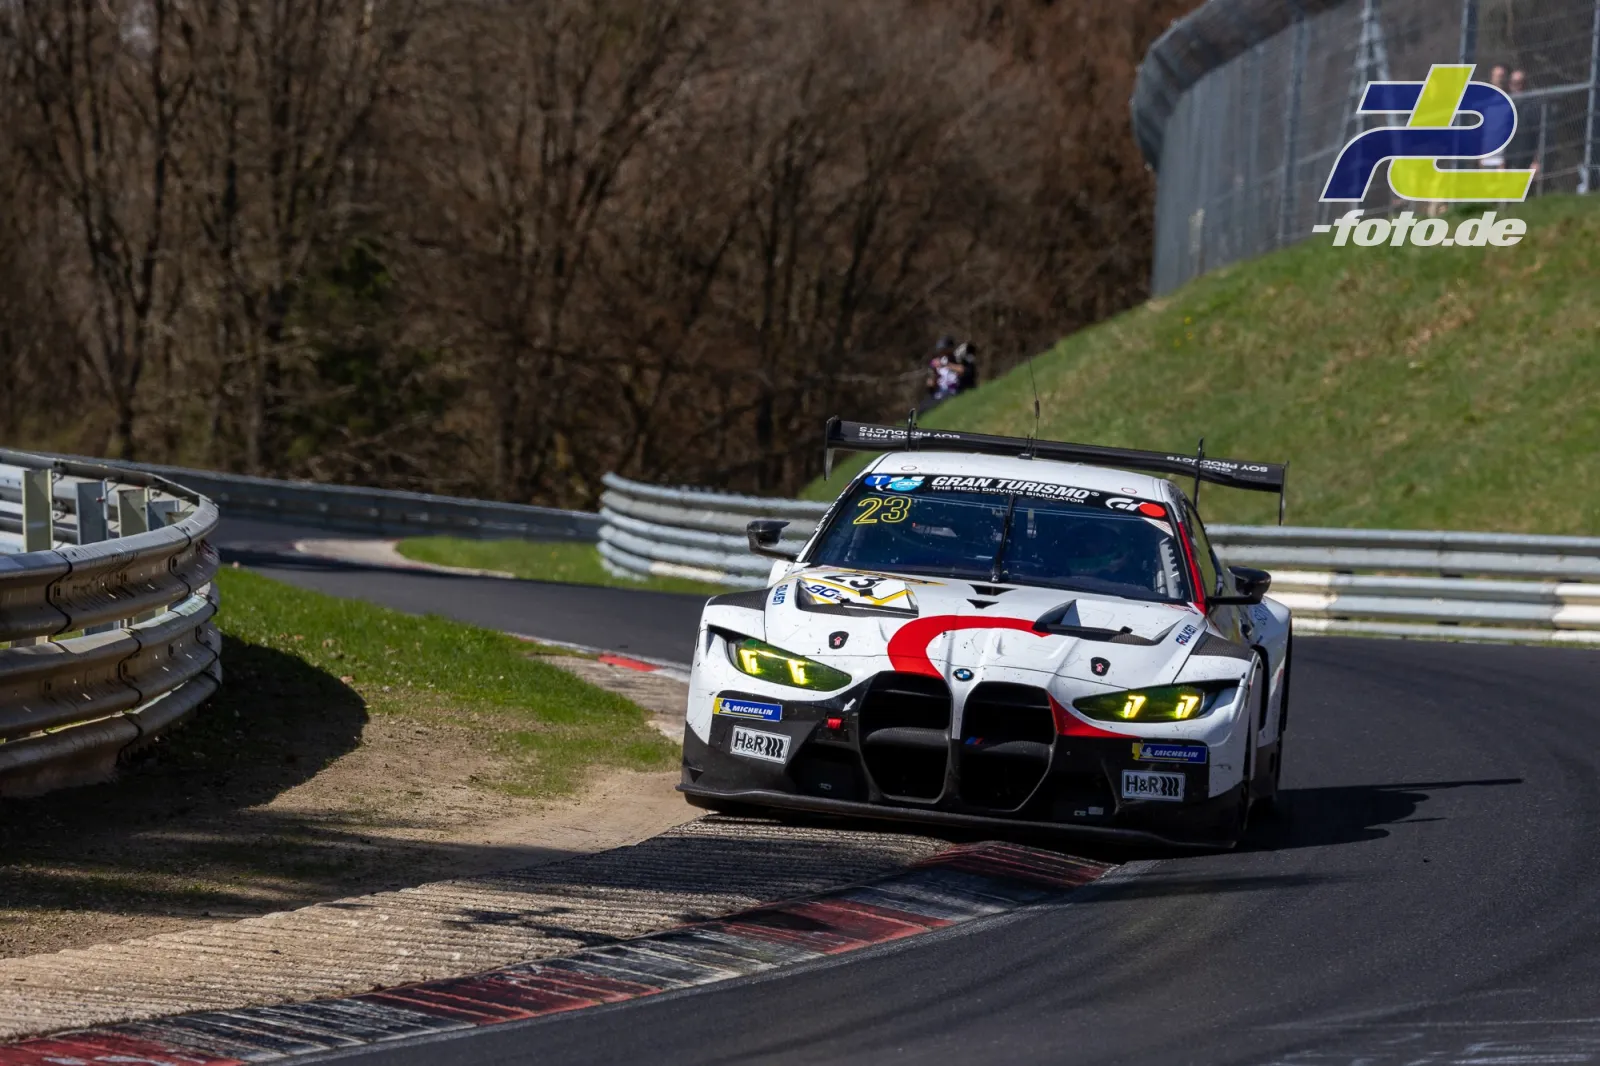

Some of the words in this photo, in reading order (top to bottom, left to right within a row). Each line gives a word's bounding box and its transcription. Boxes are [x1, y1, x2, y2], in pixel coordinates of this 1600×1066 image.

[1240, 465, 1268, 473] SOY
[931, 476, 993, 487] GRAN
[982, 487, 1024, 496] DRIVING
[1025, 491, 1085, 503] SIMULATOR
[853, 496, 912, 525] 23
[824, 573, 887, 589] 23
[732, 705, 774, 716] MICHELIN
[734, 731, 764, 752] H&R
[1153, 749, 1199, 758] MICHELIN
[1125, 774, 1159, 793] H&R
